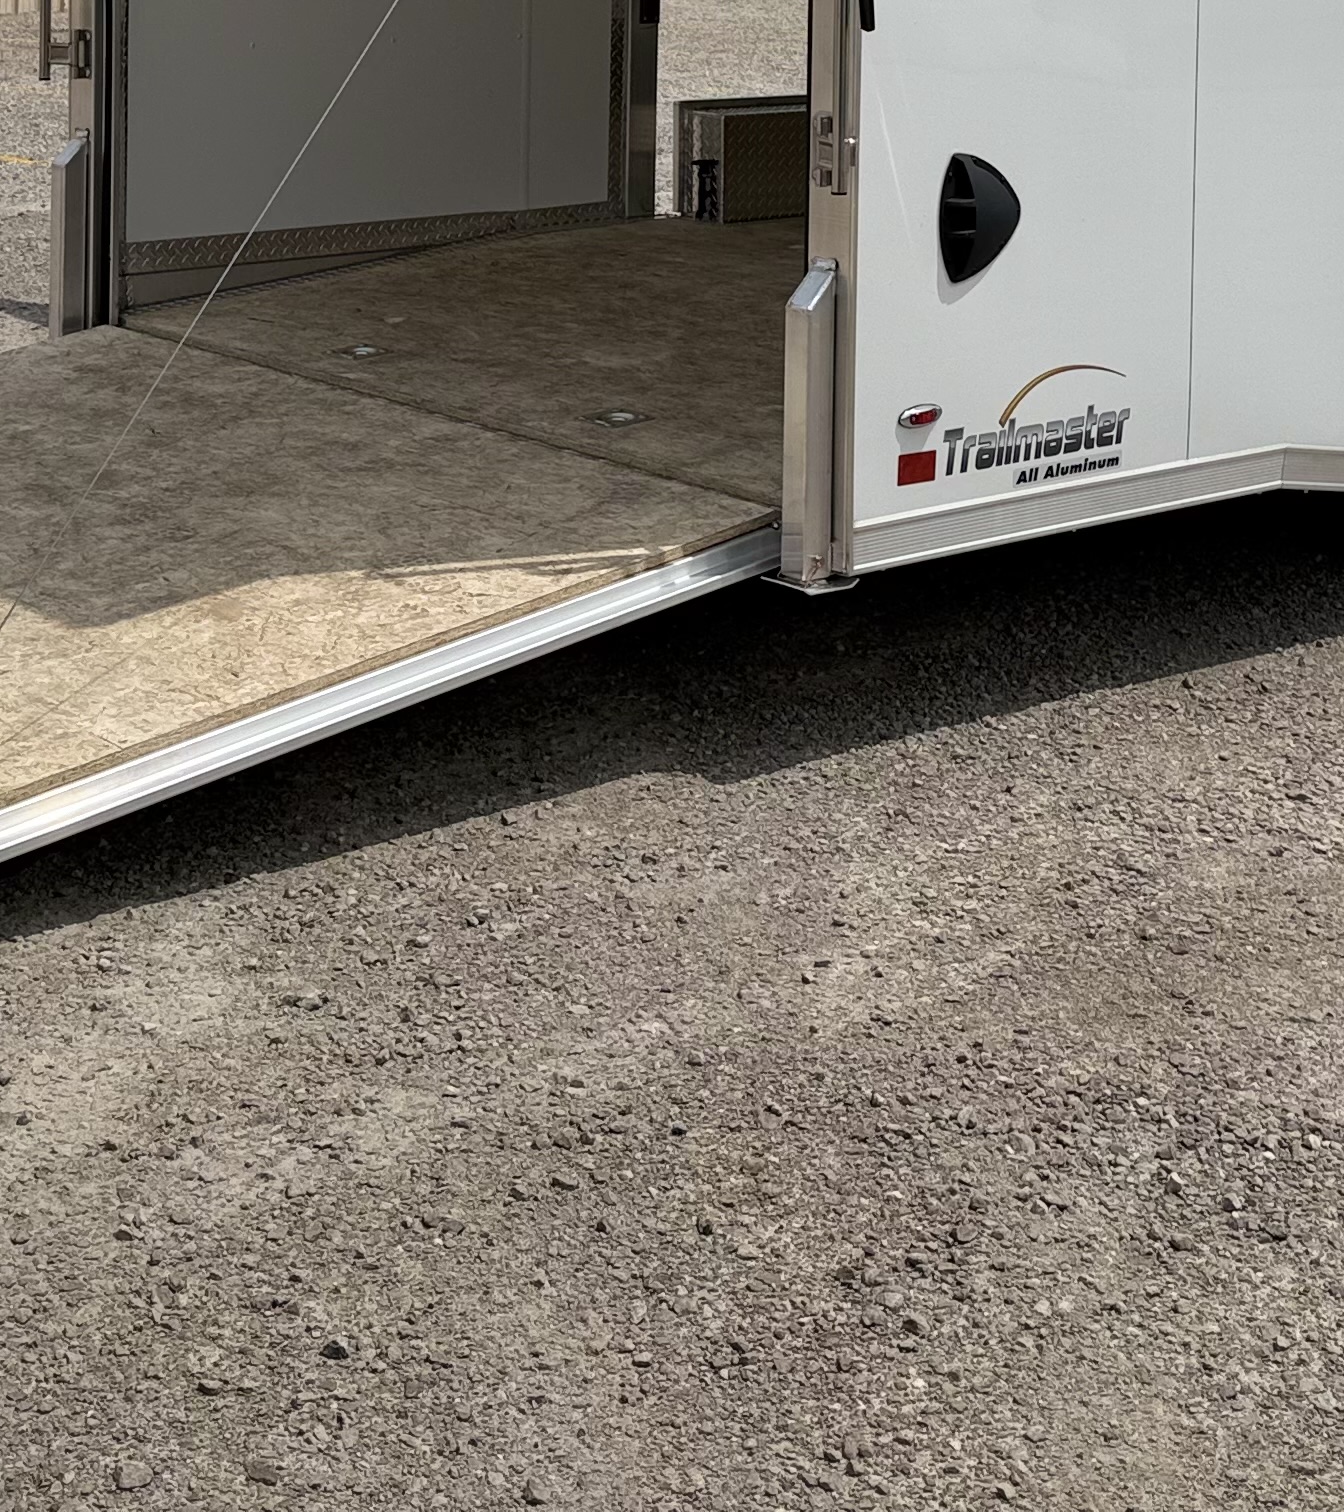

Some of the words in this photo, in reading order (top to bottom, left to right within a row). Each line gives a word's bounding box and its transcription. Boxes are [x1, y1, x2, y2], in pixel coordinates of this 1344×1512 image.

[943, 404, 1131, 476] Trailmaster
[1016, 467, 1039, 485] All
[1043, 456, 1119, 480] Aluminum
